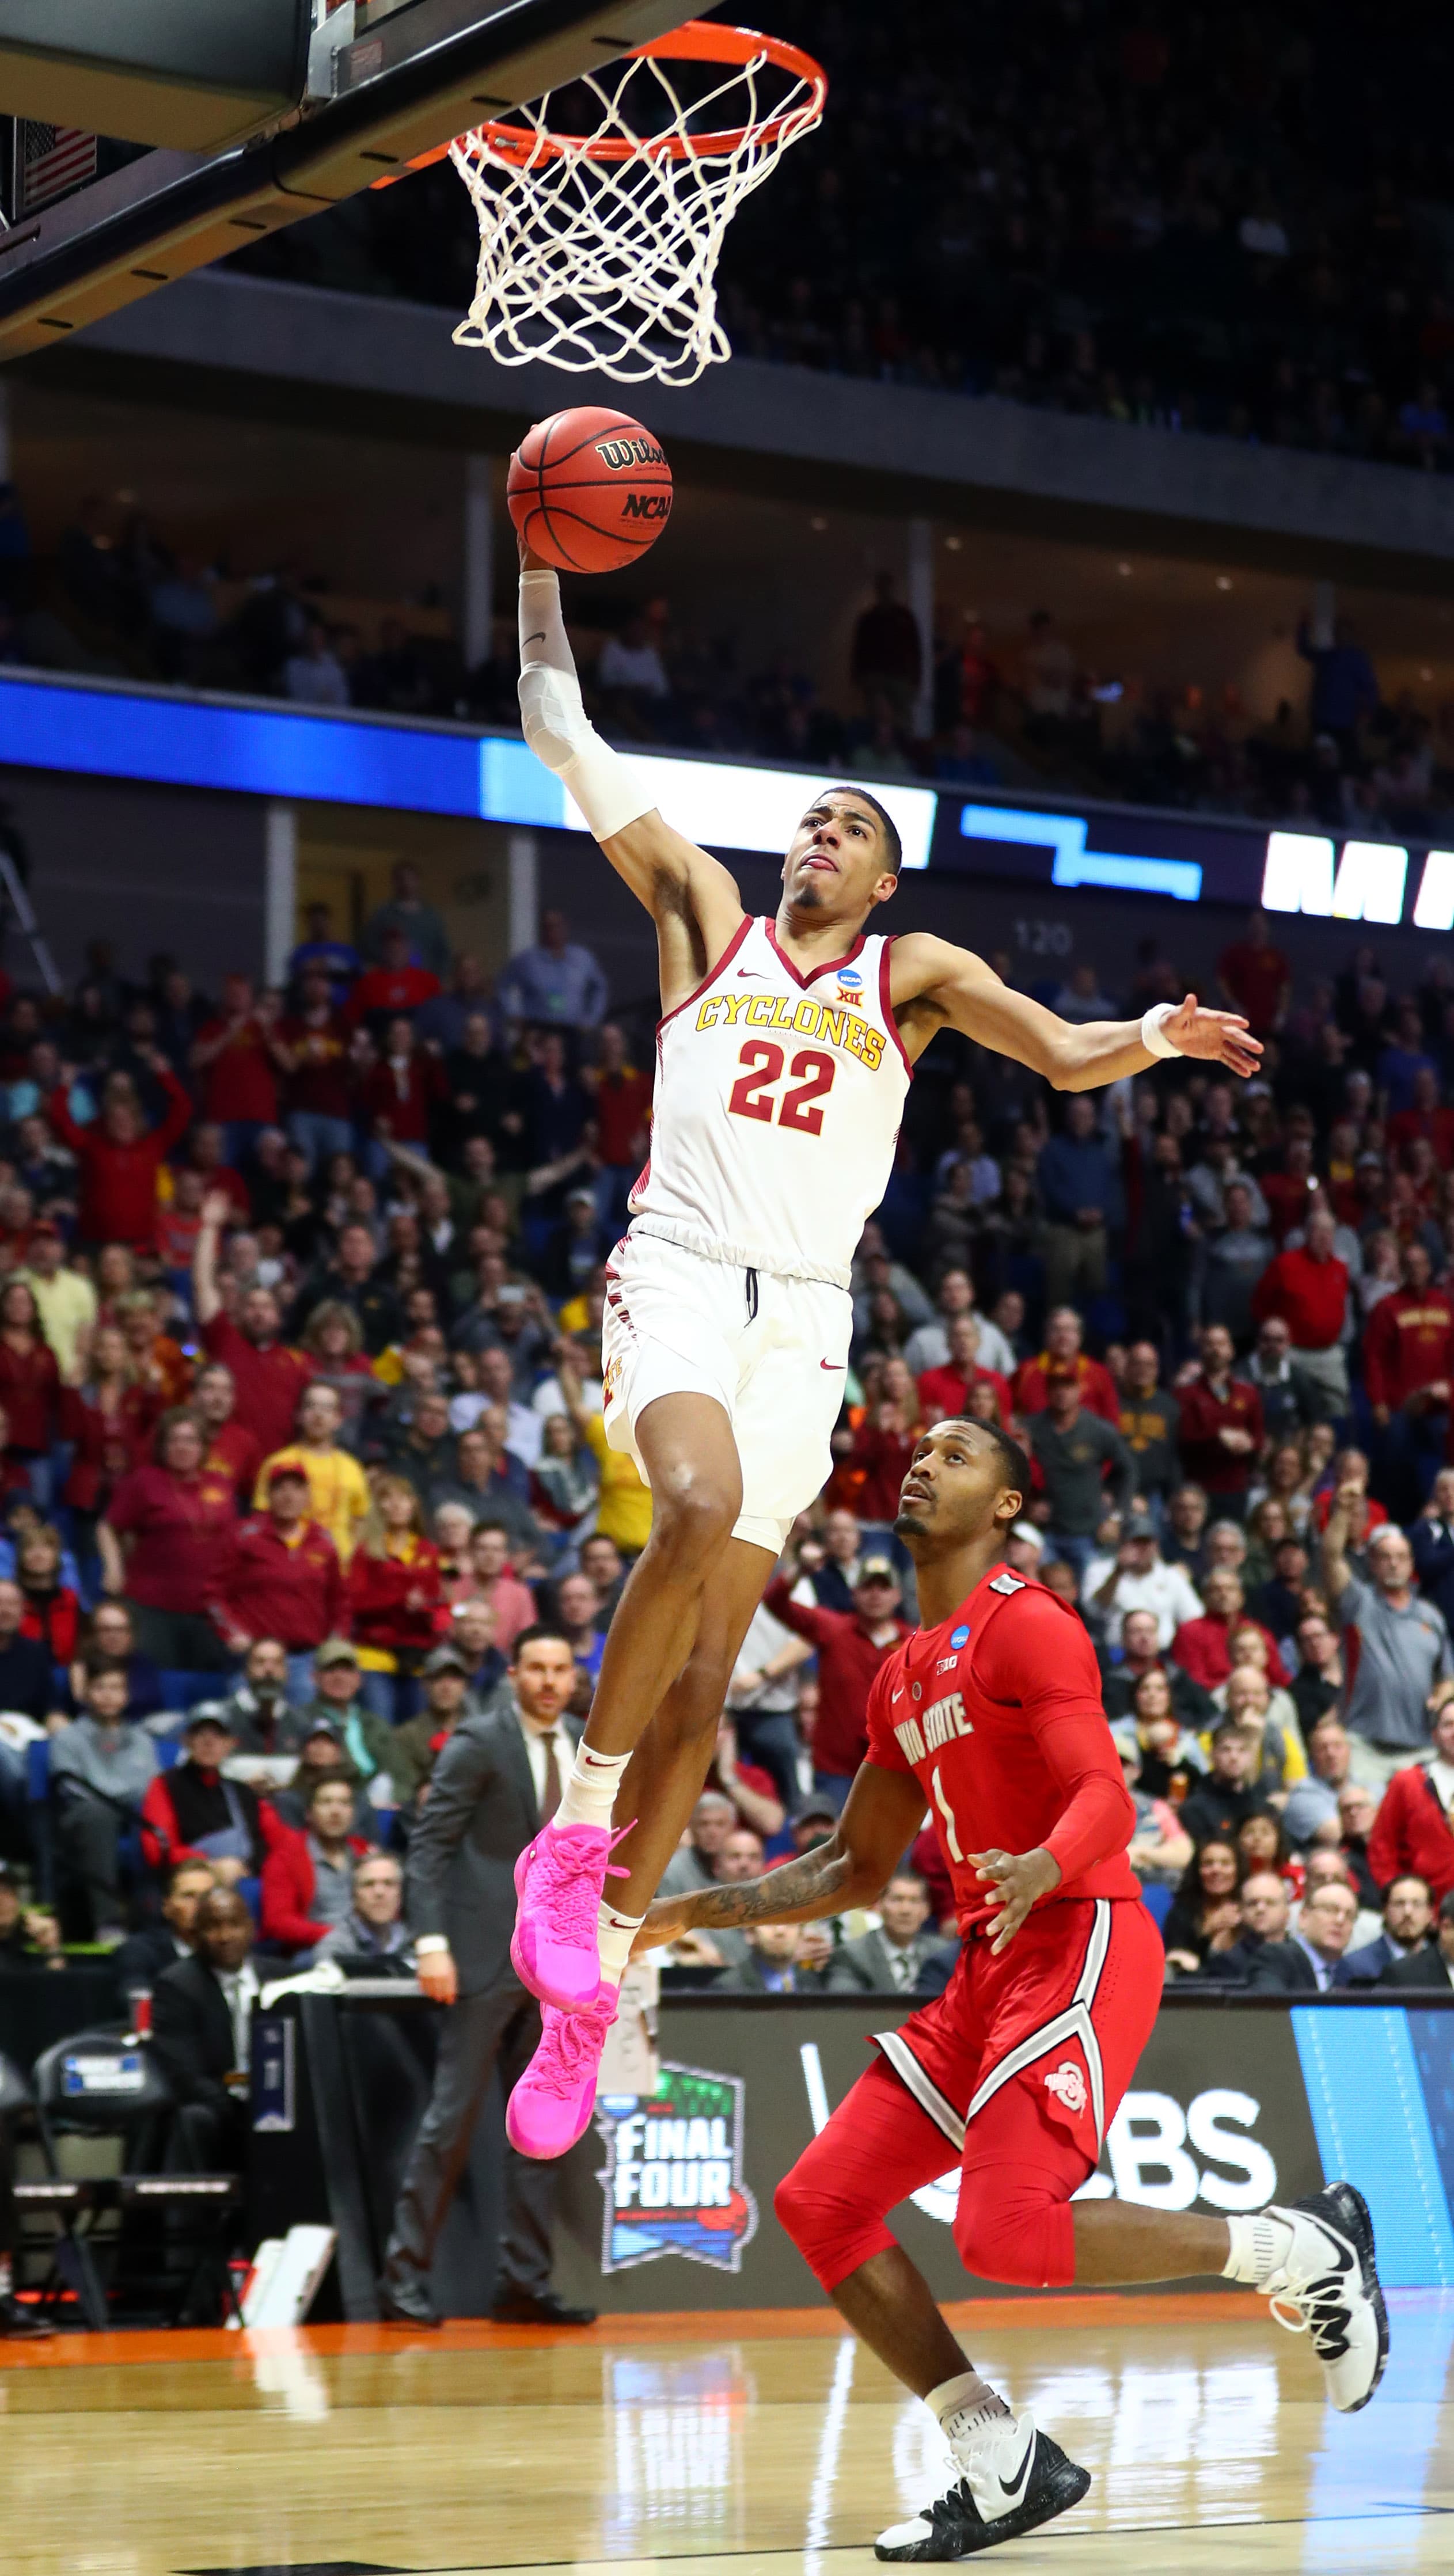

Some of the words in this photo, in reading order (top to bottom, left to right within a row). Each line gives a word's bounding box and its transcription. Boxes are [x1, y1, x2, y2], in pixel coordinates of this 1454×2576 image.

[836, 986, 864, 1008] XII
[840, 975, 863, 985] NCAA
[695, 994, 887, 1071] CYCLONES
[728, 1039, 836, 1138] 22
[922, 1692, 974, 1753] STATE
[932, 1765, 965, 1864] 1
[614, 2114, 734, 2164] FINAL
[1068, 2088, 1277, 2211] BS
[613, 2159, 732, 2208] FOUR
